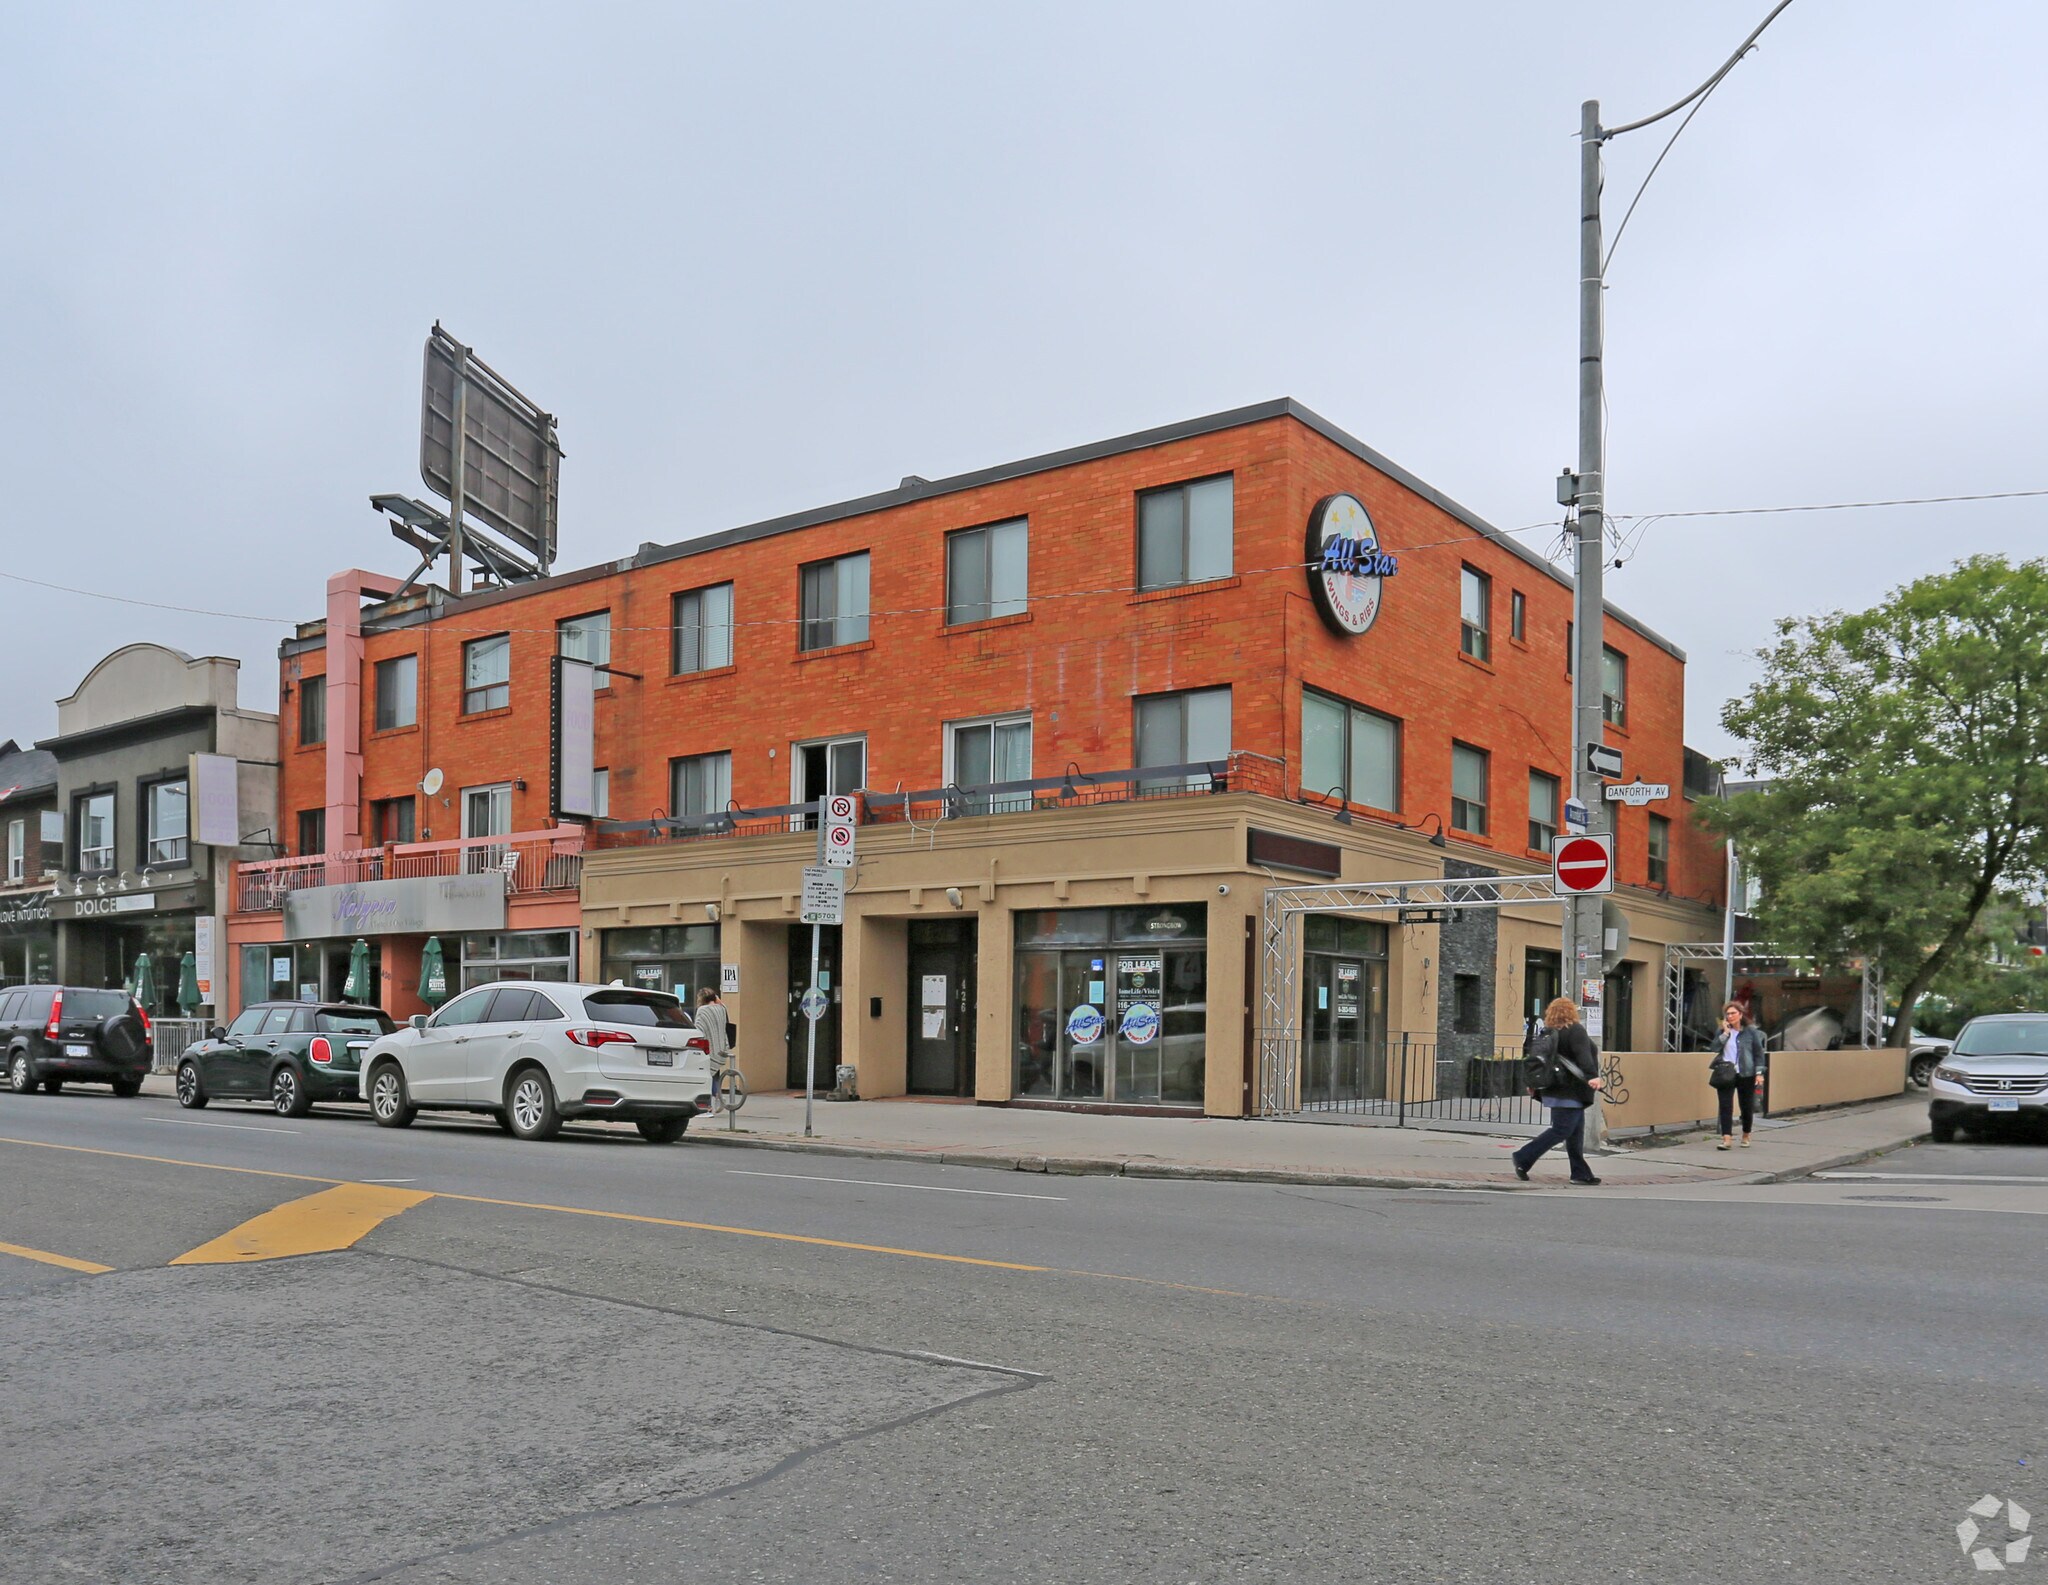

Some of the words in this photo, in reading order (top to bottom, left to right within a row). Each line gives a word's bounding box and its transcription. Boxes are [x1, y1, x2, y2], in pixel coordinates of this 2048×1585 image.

[1358, 538, 1399, 576] Star
[1327, 577, 1350, 622] WINGS
[1351, 614, 1358, 626] &
[1360, 598, 1375, 625] RIBS
[1608, 787, 1651, 797] DANFORTH
[1655, 787, 1666, 796] AV
[0, 910, 16, 923] LOVE
[17, 907, 49, 921] INTUITION
[75, 898, 117, 916] DOLCE
[1118, 960, 1133, 969] FOR
[1135, 960, 1160, 969] LEASE
[723, 968, 737, 981] IPA
